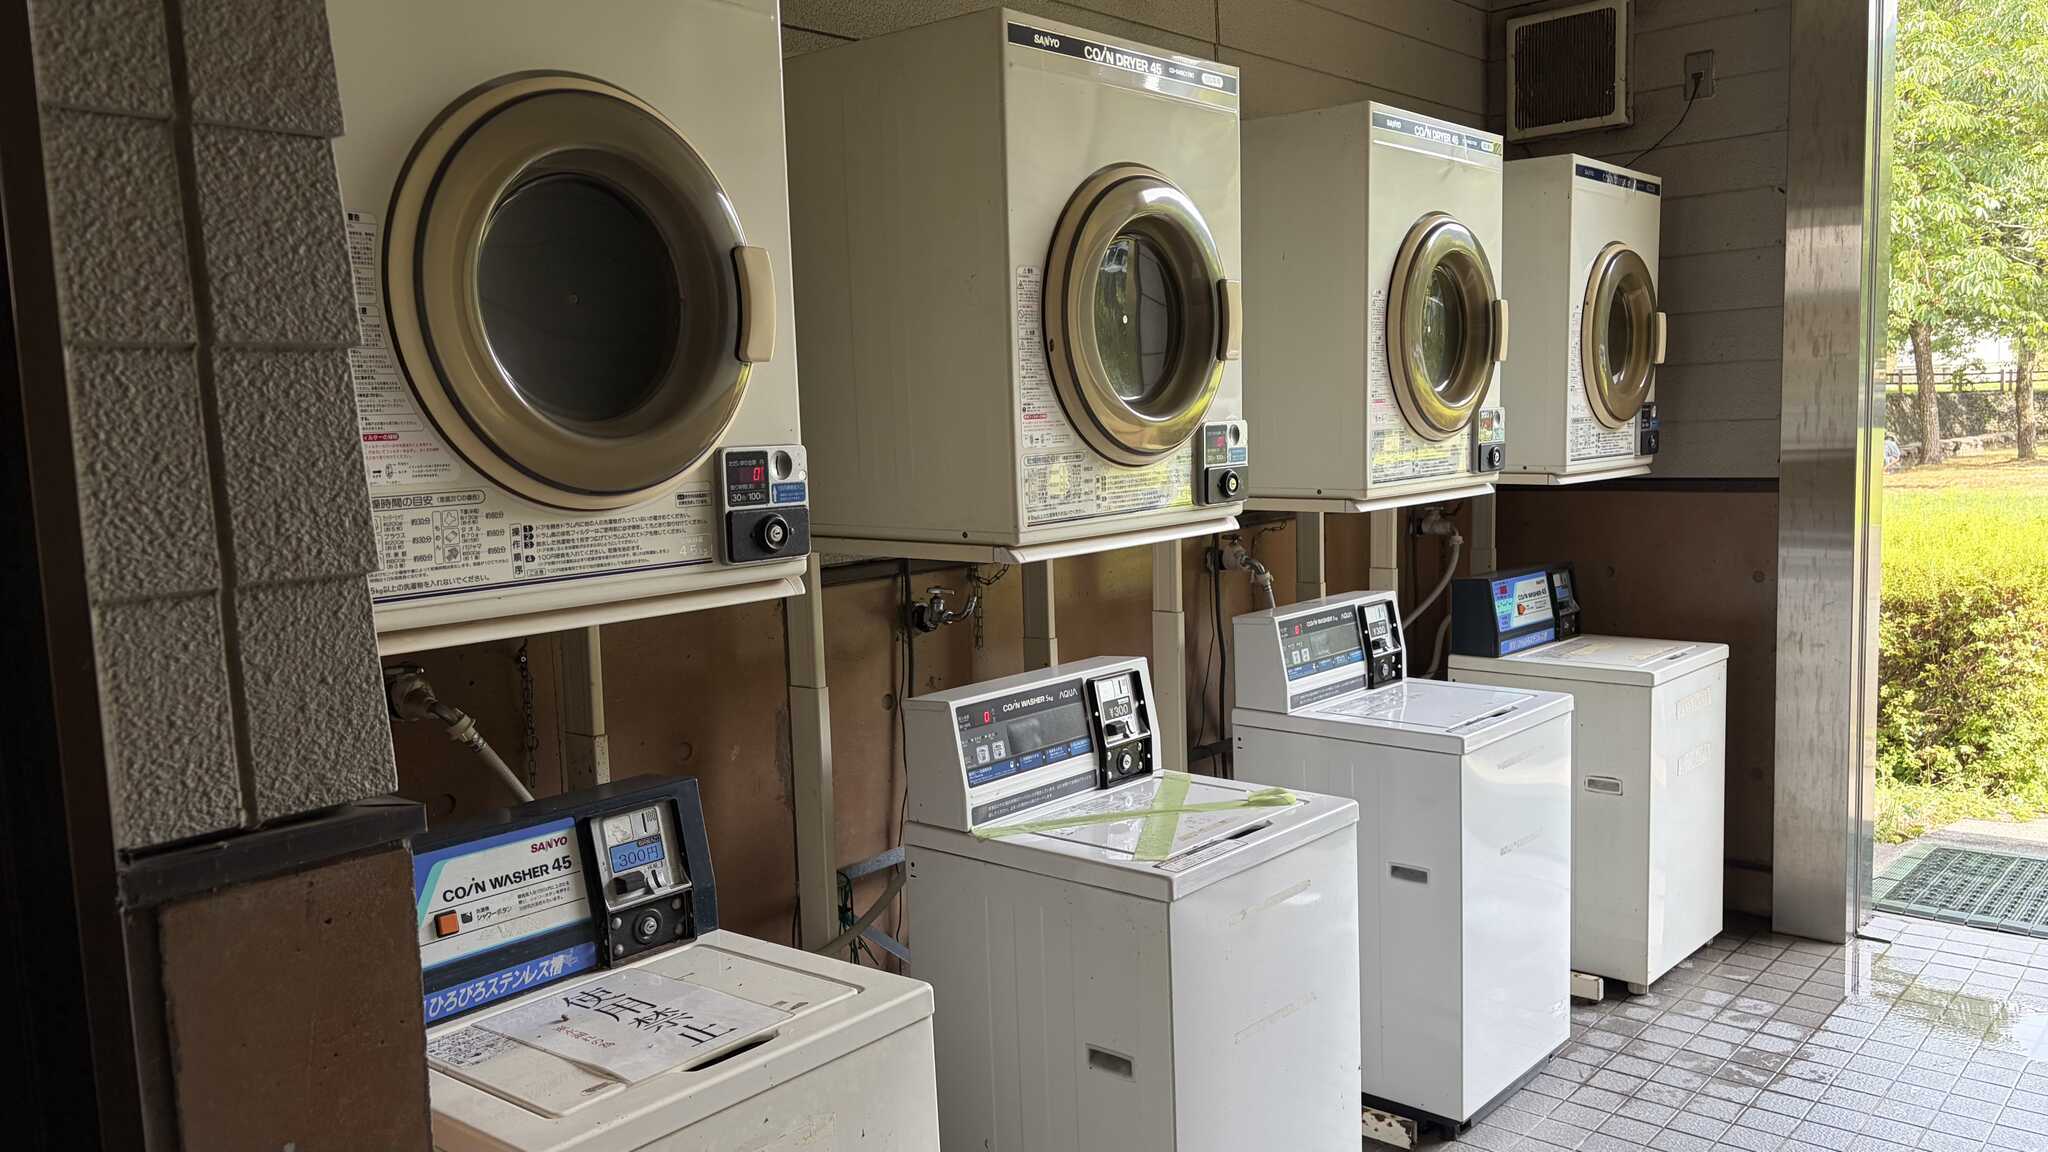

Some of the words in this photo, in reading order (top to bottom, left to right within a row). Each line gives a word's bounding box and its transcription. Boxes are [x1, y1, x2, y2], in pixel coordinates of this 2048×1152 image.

[1034, 34, 1060, 48] SANYO
[1116, 54, 1149, 73] DRYER
[1150, 62, 1162, 75] 45
[1020, 695, 1045, 708] WASHER
[1059, 687, 1078, 700] AQUA
[983, 711, 990, 724] 0
[1109, 703, 1129, 719] ¥300
[530, 836, 568, 855] SANYO
[618, 845, 659, 868] 300円
[491, 863, 550, 890] WASHER
[551, 855, 573, 872] 45
[429, 954, 565, 1017] ひろびろステンレス槽
[563, 987, 737, 1048] 使用禁止
